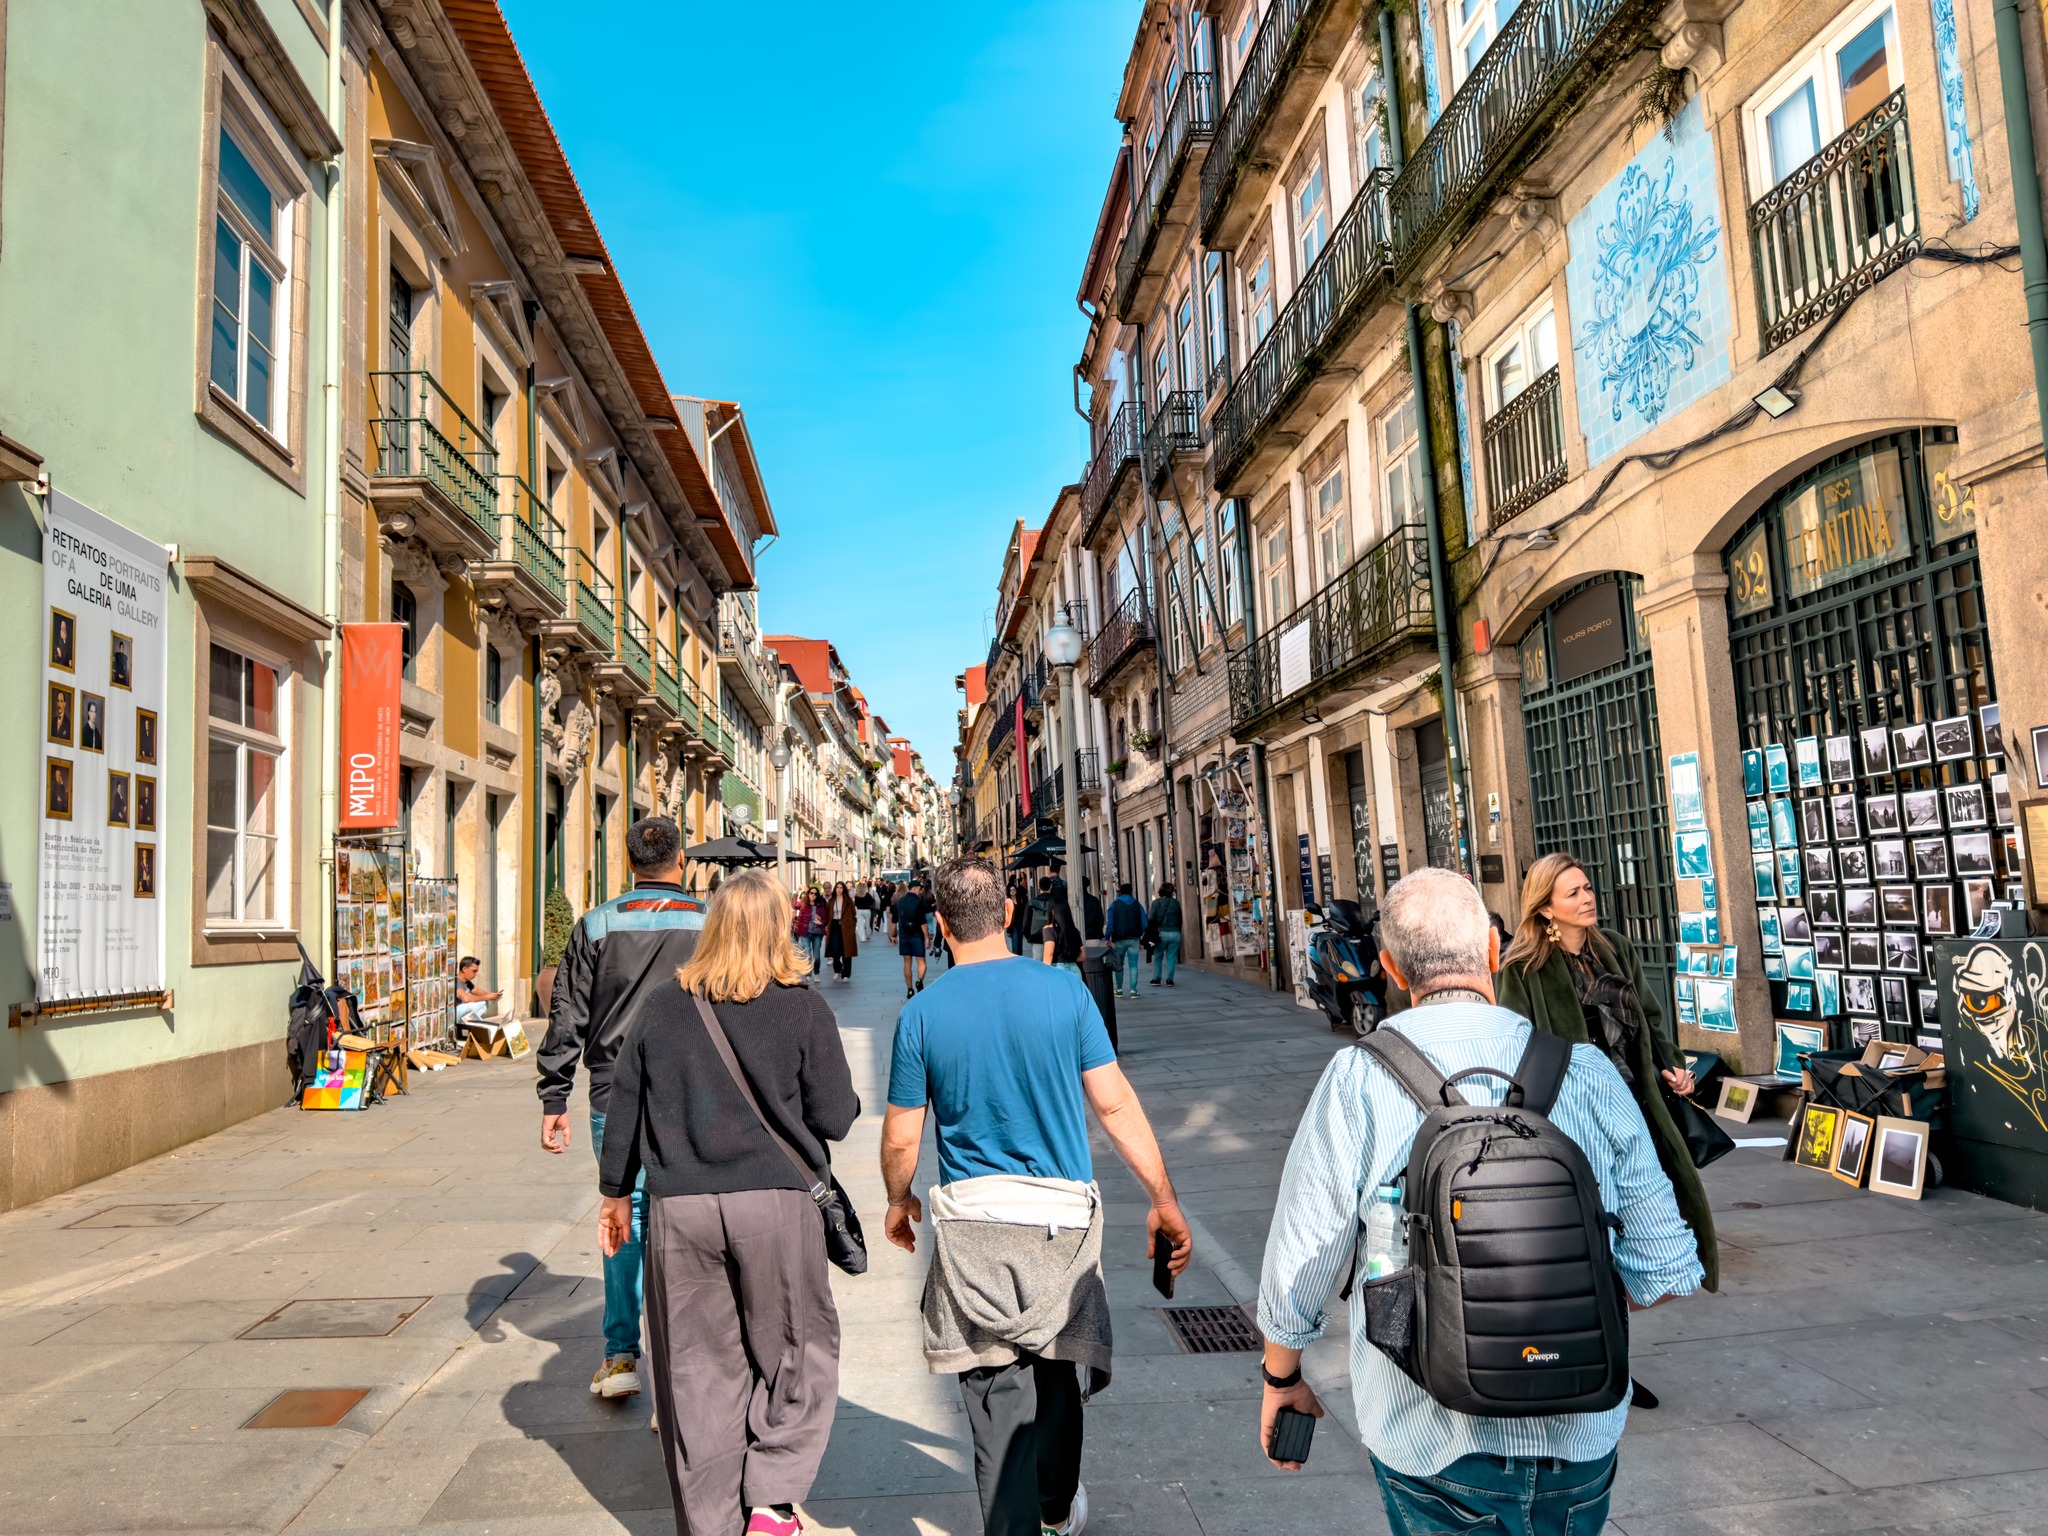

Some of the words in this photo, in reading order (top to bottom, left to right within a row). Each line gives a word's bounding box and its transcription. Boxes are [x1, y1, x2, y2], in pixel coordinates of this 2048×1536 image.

[52, 528, 107, 568] RETRATOS
[109, 556, 160, 592] PORTRAITS
[1801, 497, 1892, 580] CANTINA
[52, 550, 67, 568] OF
[68, 558, 76, 574] A
[100, 572, 113, 590] DE
[115, 579, 136, 601] UMA
[1734, 551, 1768, 603] 32
[68, 579, 112, 610] GALERIA
[118, 601, 158, 628] GALLERY
[1562, 630, 1586, 644] YOURS
[1587, 618, 1612, 634] PORTO
[350, 753, 376, 816] MIPO
